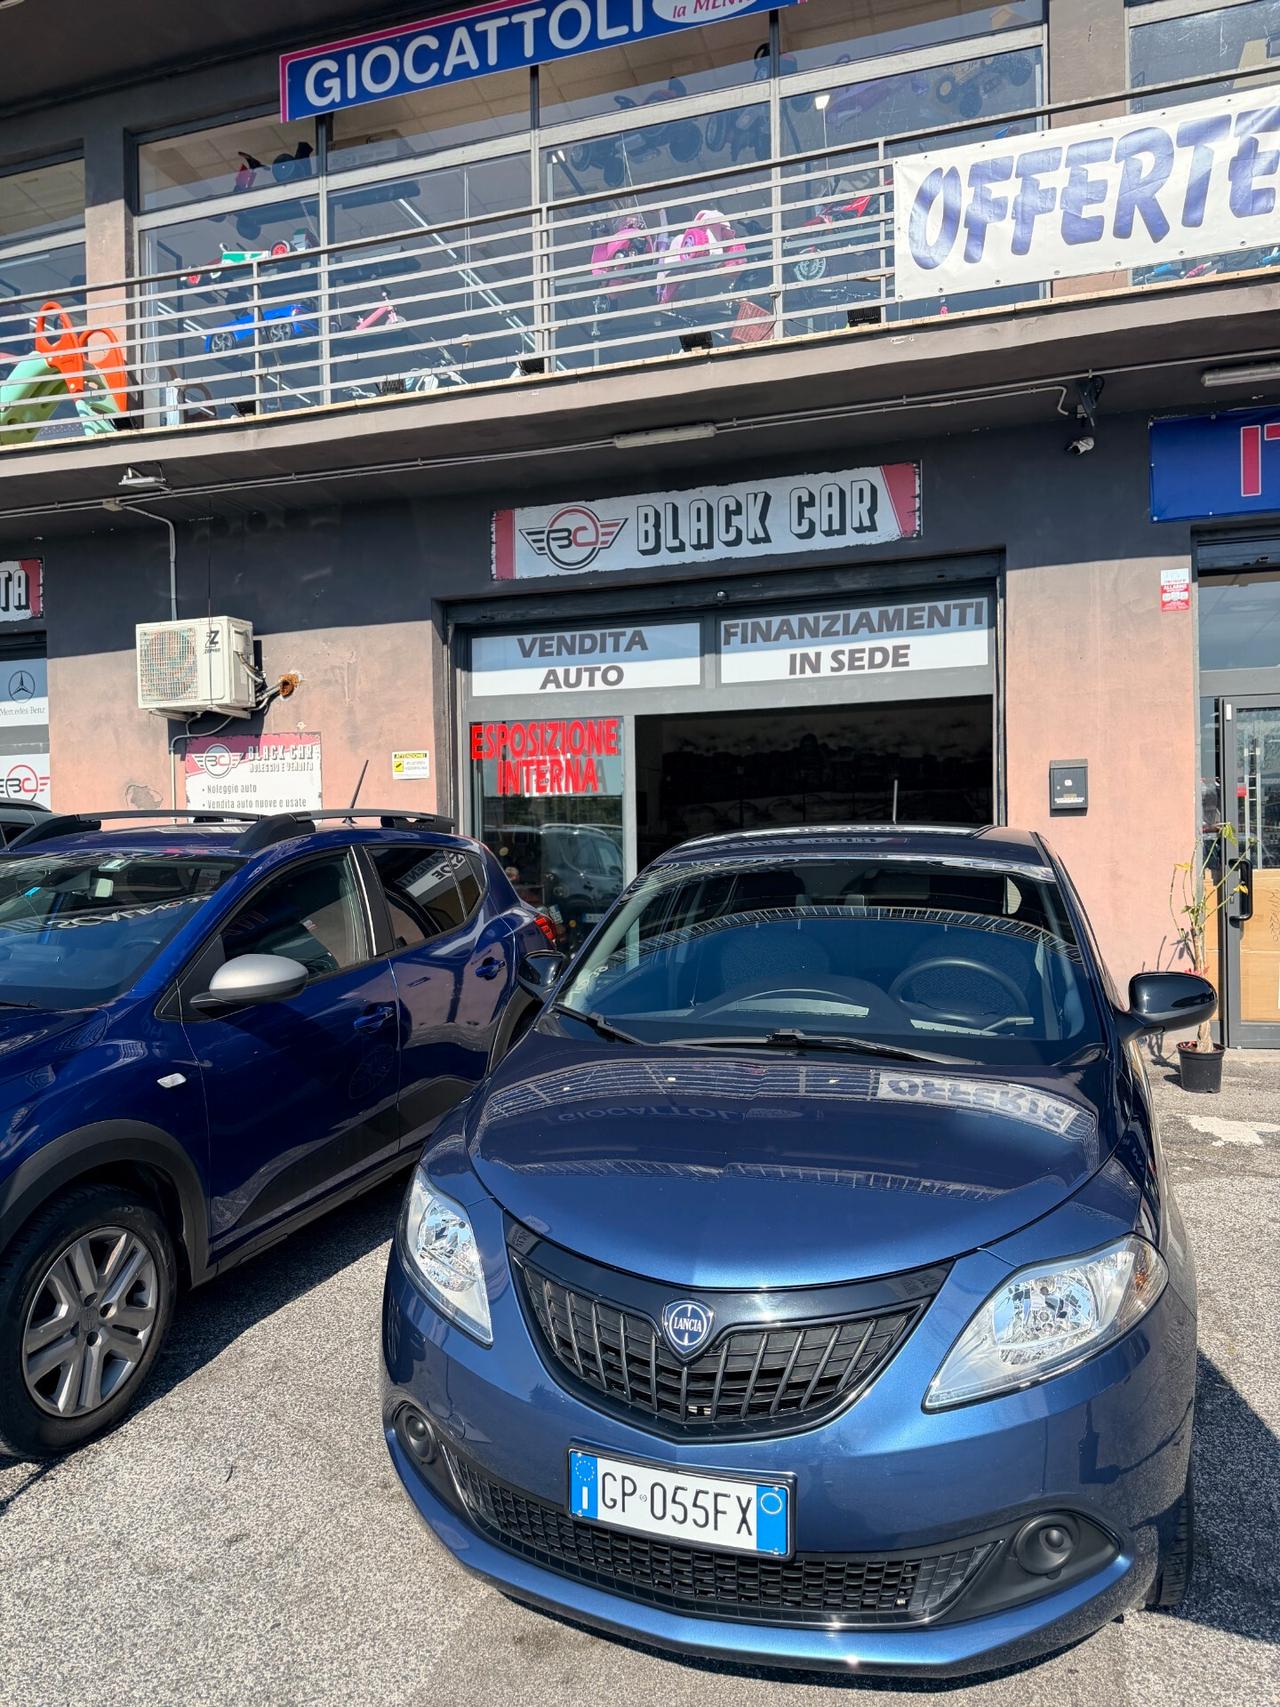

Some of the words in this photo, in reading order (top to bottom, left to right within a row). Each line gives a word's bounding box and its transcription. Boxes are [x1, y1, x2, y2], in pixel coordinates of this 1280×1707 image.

[672, 5, 686, 19] la
[305, 0, 642, 107] GIOCATTOLI
[908, 105, 1280, 271] OFFERTE
[636, 490, 772, 557] BLACK
[789, 478, 879, 539] CAR
[722, 600, 984, 647] FINANZIAMENTI
[517, 629, 649, 658] VENDITA
[789, 651, 821, 676] IN
[829, 644, 911, 673] SEDE
[539, 664, 625, 690] AUTO
[30, 705, 46, 714] Benz
[248, 745, 286, 762] BLACK
[291, 744, 315, 761] CAR
[470, 718, 619, 761] ESPOSIZIONE
[207, 784, 239, 795] Noleggio
[240, 783, 257, 793] auto
[496, 756, 599, 797] INTERNA
[208, 799, 235, 809] Vendita
[237, 799, 253, 809] auto
[255, 800, 278, 808] nuove
[279, 800, 284, 808] e
[285, 798, 307, 808] usate
[673, 1316, 703, 1333] LANCIA
[601, 1471, 637, 1514] GP
[650, 1482, 753, 1537] 055FX
